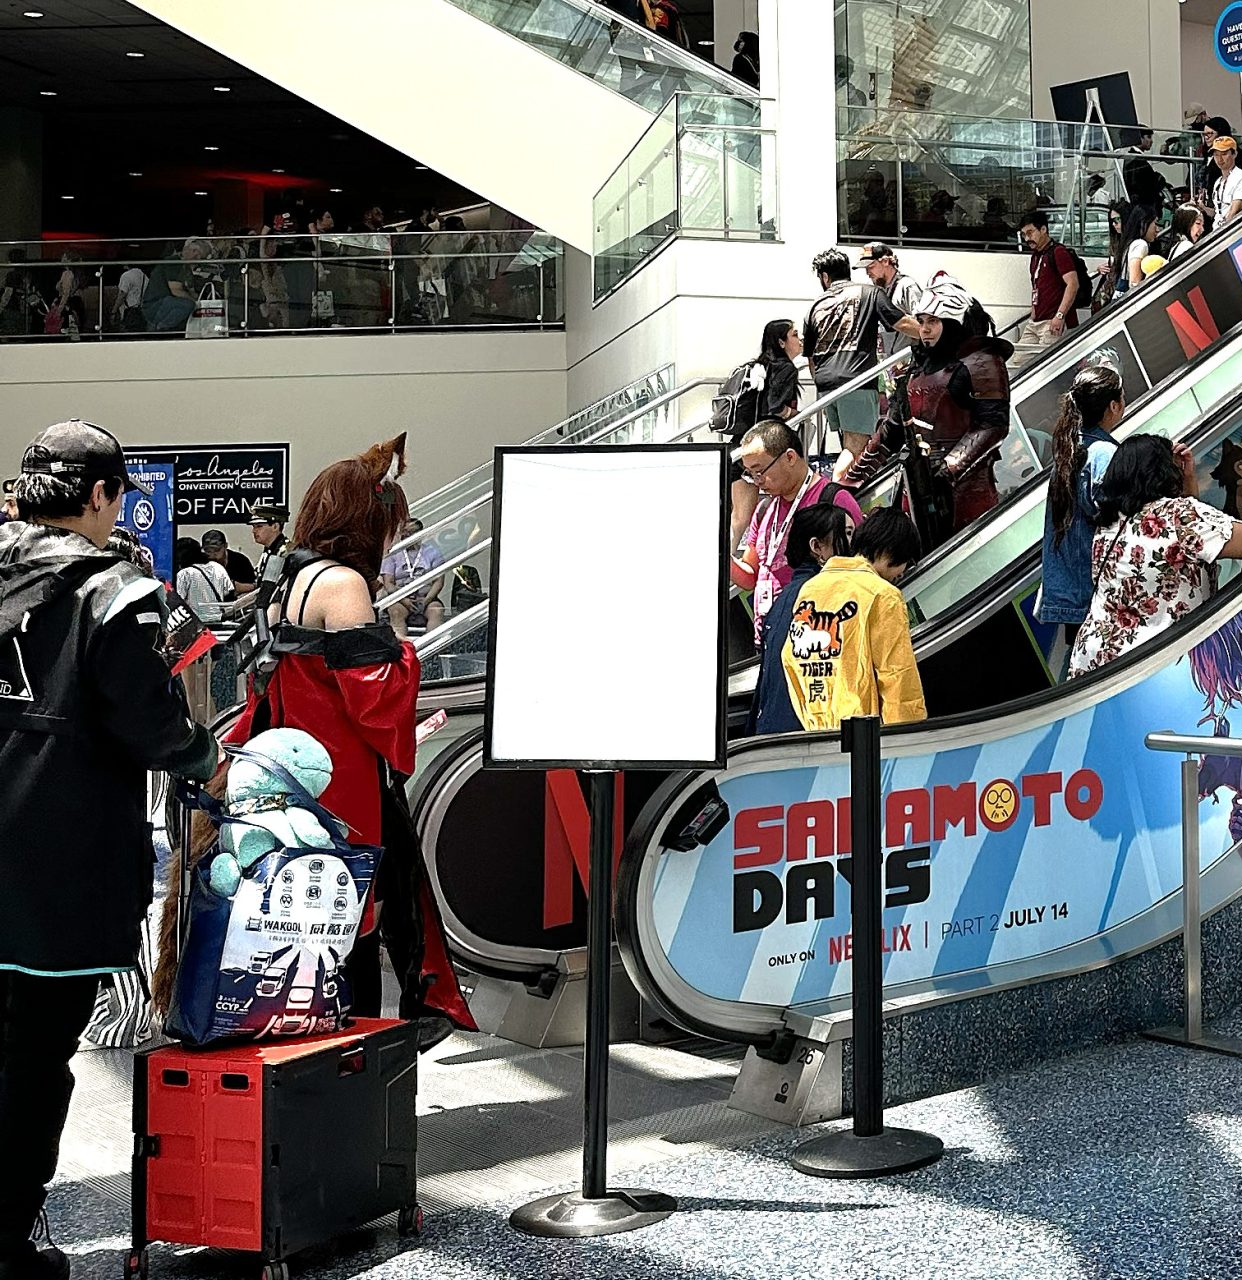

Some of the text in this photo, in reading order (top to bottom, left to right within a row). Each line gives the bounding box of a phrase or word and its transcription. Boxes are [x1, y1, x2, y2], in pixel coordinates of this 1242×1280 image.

[1227, 22, 1242, 34] HAVE
[1226, 43, 1239, 54] ASK
[207, 454, 274, 485] Angeles
[128, 471, 166, 482] OHIBITED
[178, 481, 274, 491] ONVENTION CENTER
[799, 662, 834, 678] TIGER
[809, 679, 826, 703] 虎
[263, 920, 303, 932] WAKOOL
[768, 901, 1070, 968] ONLY ON NELIX PART 2 JULY 14
[215, 1001, 240, 1011] CCYP
[797, 1046, 815, 1065] 26
